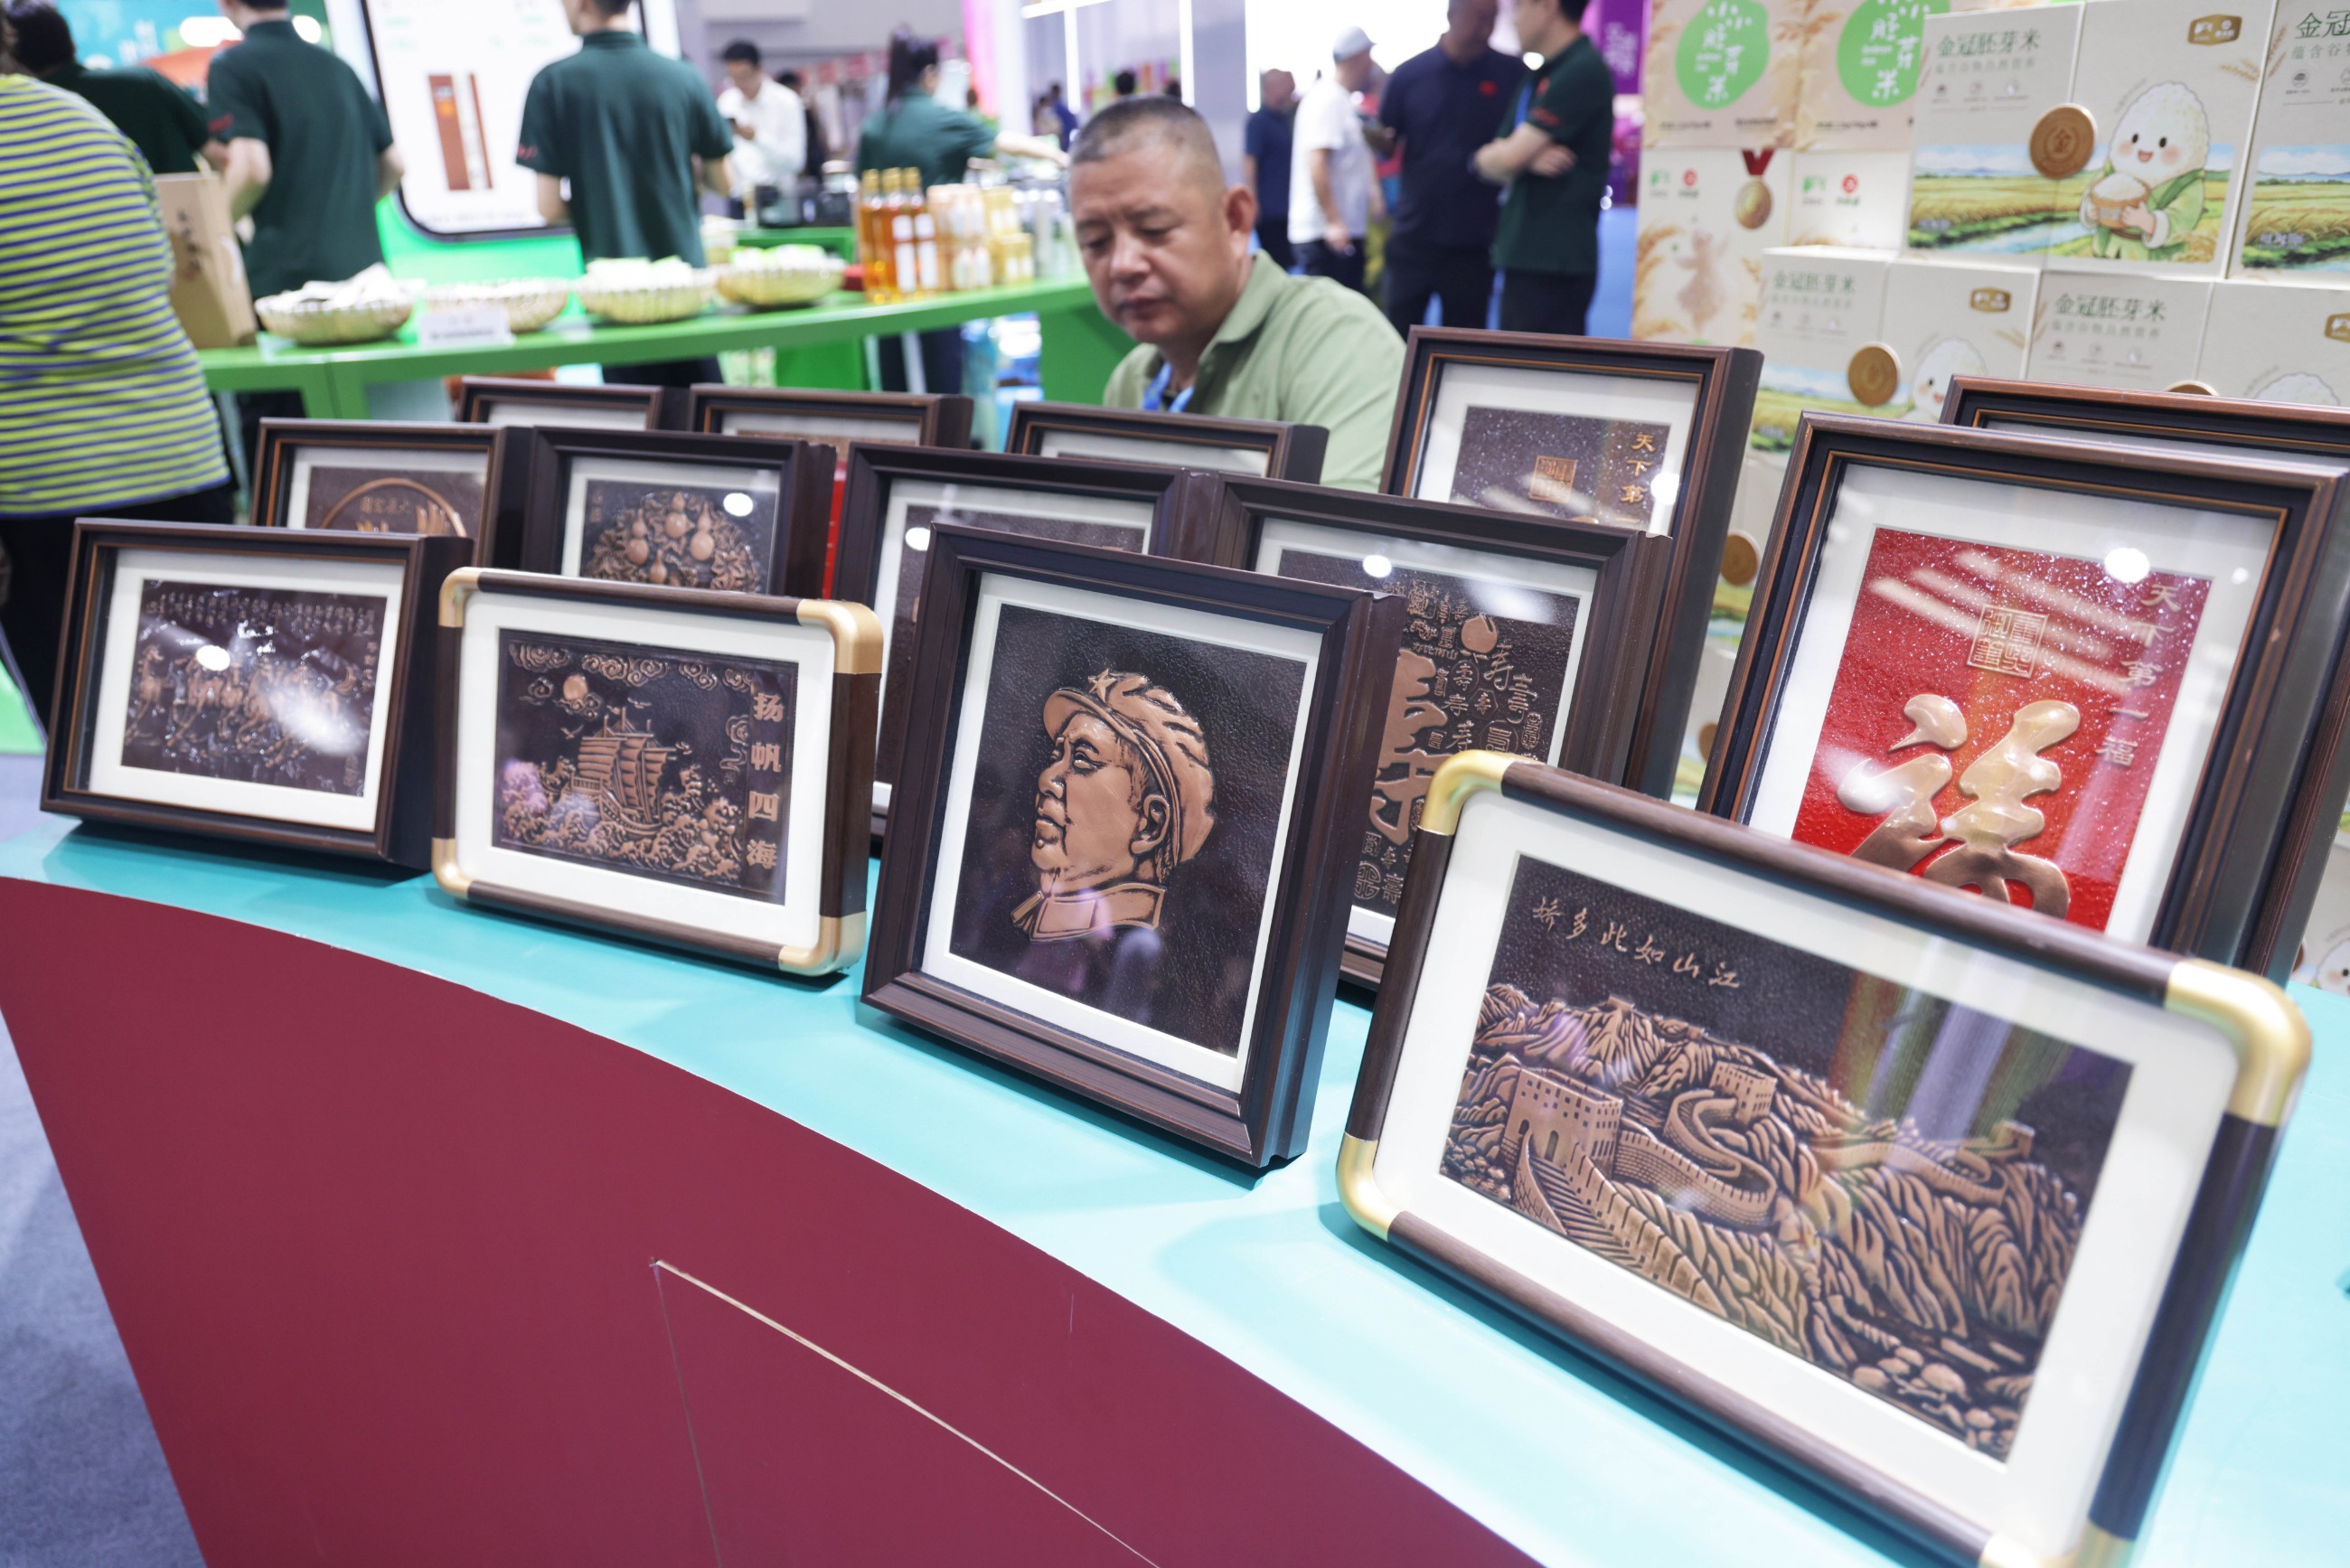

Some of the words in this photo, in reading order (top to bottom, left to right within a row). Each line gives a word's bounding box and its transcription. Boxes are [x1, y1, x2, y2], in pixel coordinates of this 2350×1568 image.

[2094, 583, 2182, 767] 天下第一福
[746, 691, 785, 869] 扬帆四海
